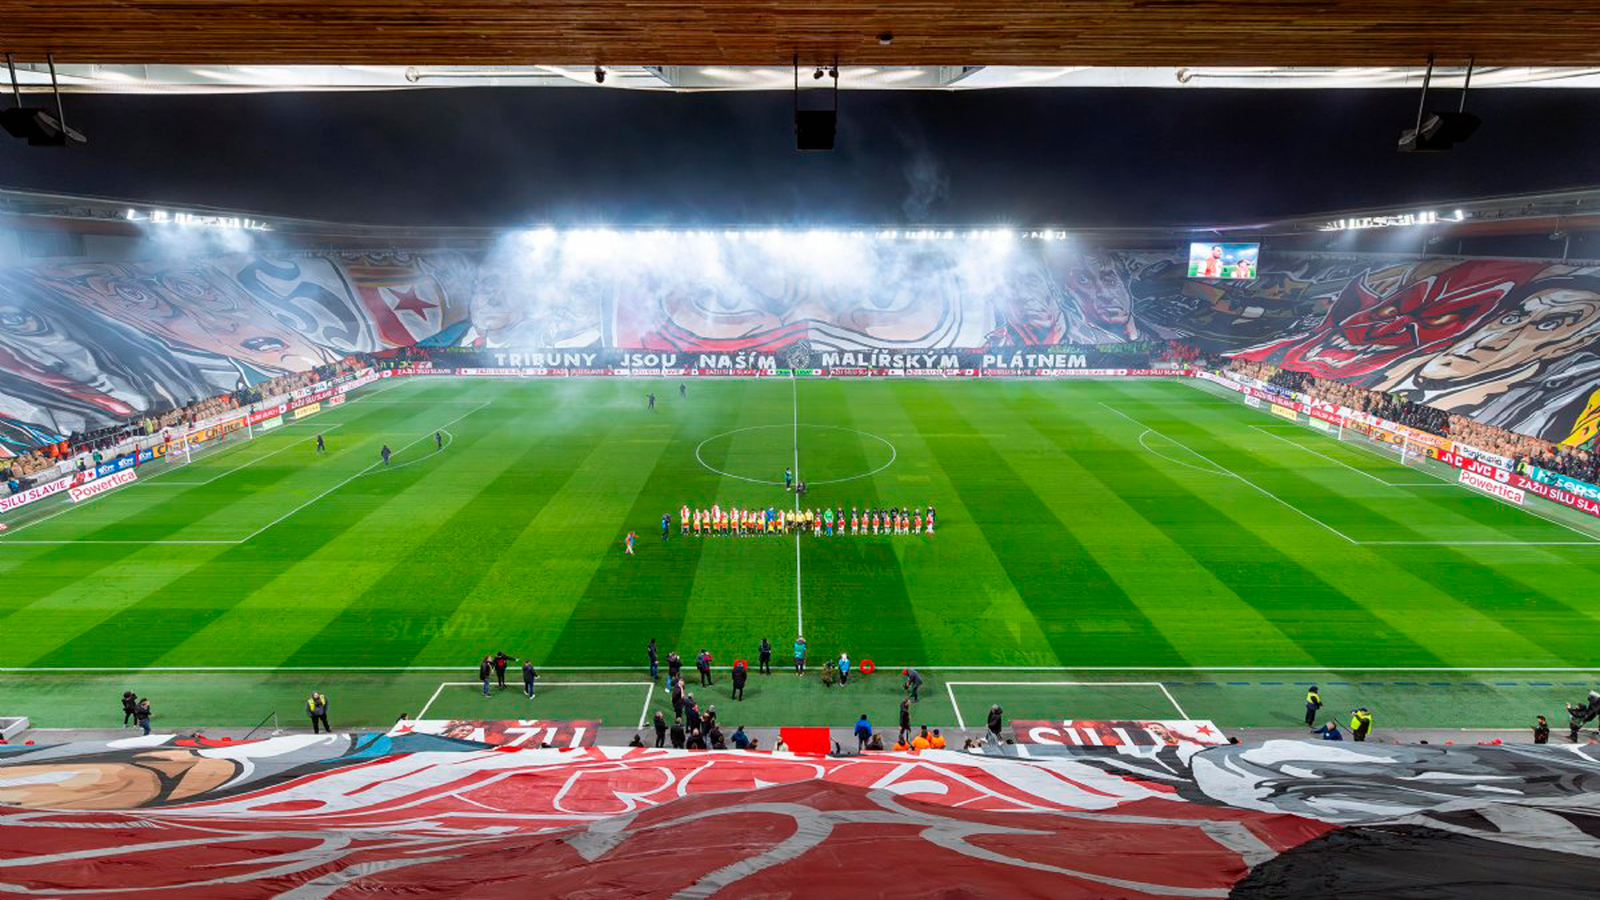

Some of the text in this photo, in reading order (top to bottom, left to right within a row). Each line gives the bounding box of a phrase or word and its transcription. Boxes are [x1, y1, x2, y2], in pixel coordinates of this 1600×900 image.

[495, 349, 1087, 369] TRIBUNY JSOU NAŠÍM MALÍŘSKÝM PLÁTNEM
[1468, 461, 1492, 475] JVC
[29, 480, 67, 500] SLAVIE
[72, 470, 136, 501] Powertica
[1461, 470, 1523, 503] Powertica
[1518, 477, 1600, 514] ZAŽU SÍLU SLA
[1535, 469, 1600, 499] Hsens
